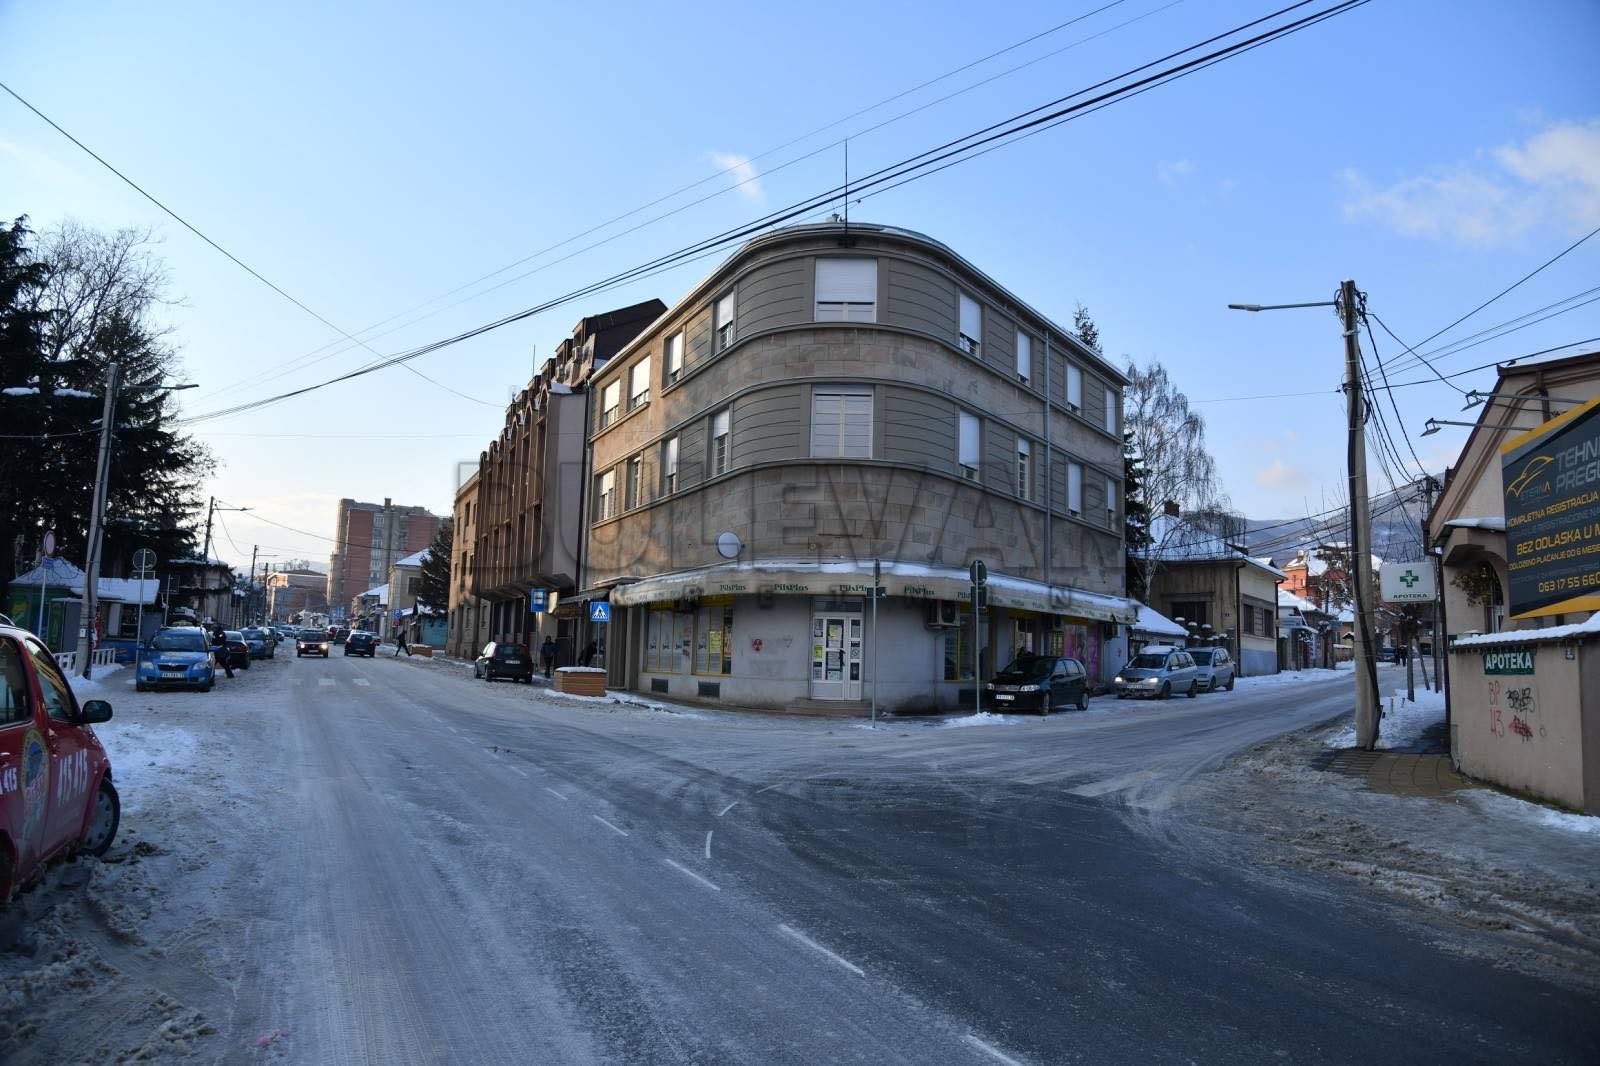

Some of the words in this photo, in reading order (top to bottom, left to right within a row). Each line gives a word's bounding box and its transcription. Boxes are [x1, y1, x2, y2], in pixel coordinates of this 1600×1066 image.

[1507, 508, 1546, 528] KOMPLETNA
[1546, 491, 1600, 516] REGISTRACIJA
[1516, 539, 1534, 556] BEZ
[1535, 528, 1582, 551] ODLASKA
[1584, 524, 1592, 539] U
[1567, 549, 1576, 558] DO
[1538, 581, 1555, 593] 063
[1557, 578, 1566, 591] 17
[1567, 576, 1580, 589] 55
[1485, 652, 1533, 669] APOTEKA
[4, 767, 17, 792] 415
